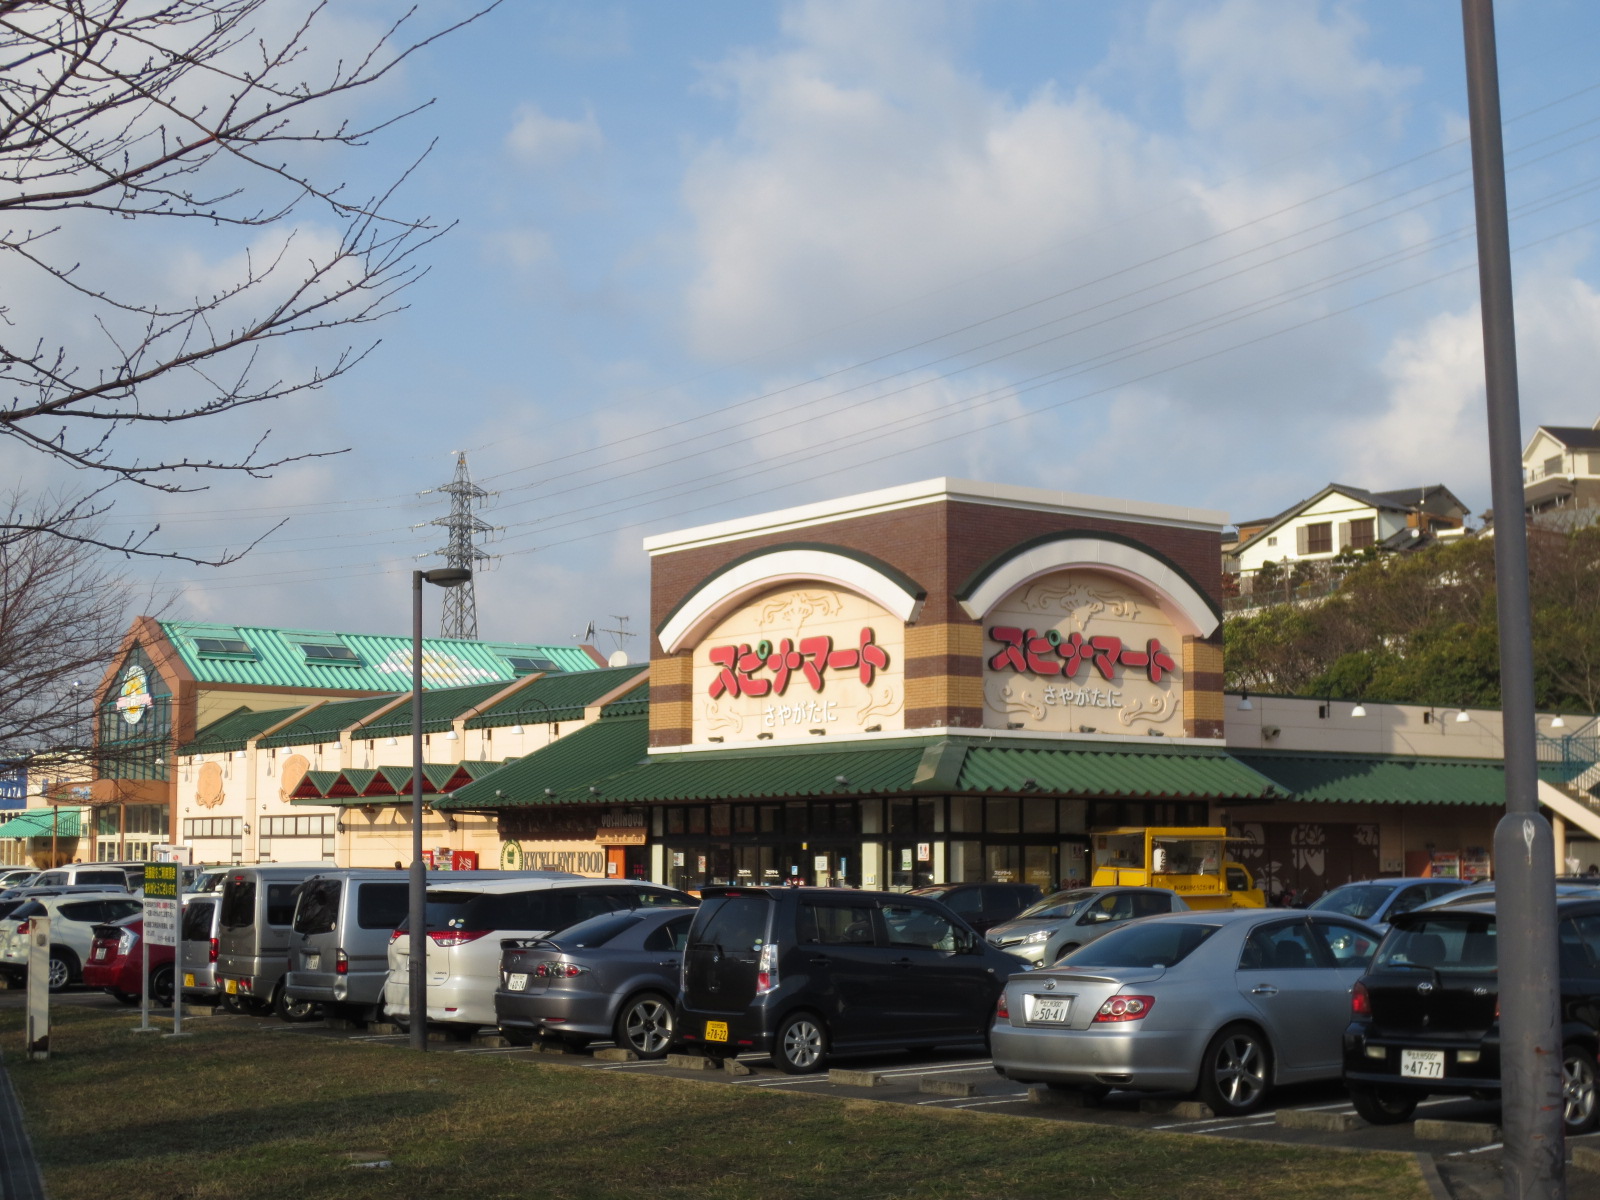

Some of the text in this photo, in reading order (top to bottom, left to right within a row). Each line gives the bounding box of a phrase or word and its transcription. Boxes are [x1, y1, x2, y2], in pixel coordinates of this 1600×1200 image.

[708, 626, 889, 699] スピナマート
[989, 626, 1176, 683] スピナマート
[1044, 685, 1123, 708] さやがたに
[764, 700, 838, 727] さやがたに
[523, 851, 575, 873] EXCELLENT
[577, 851, 604, 873] FOOD
[1039, 1008, 1064, 1021] 50-41
[1410, 1060, 1442, 1076] 47-77
